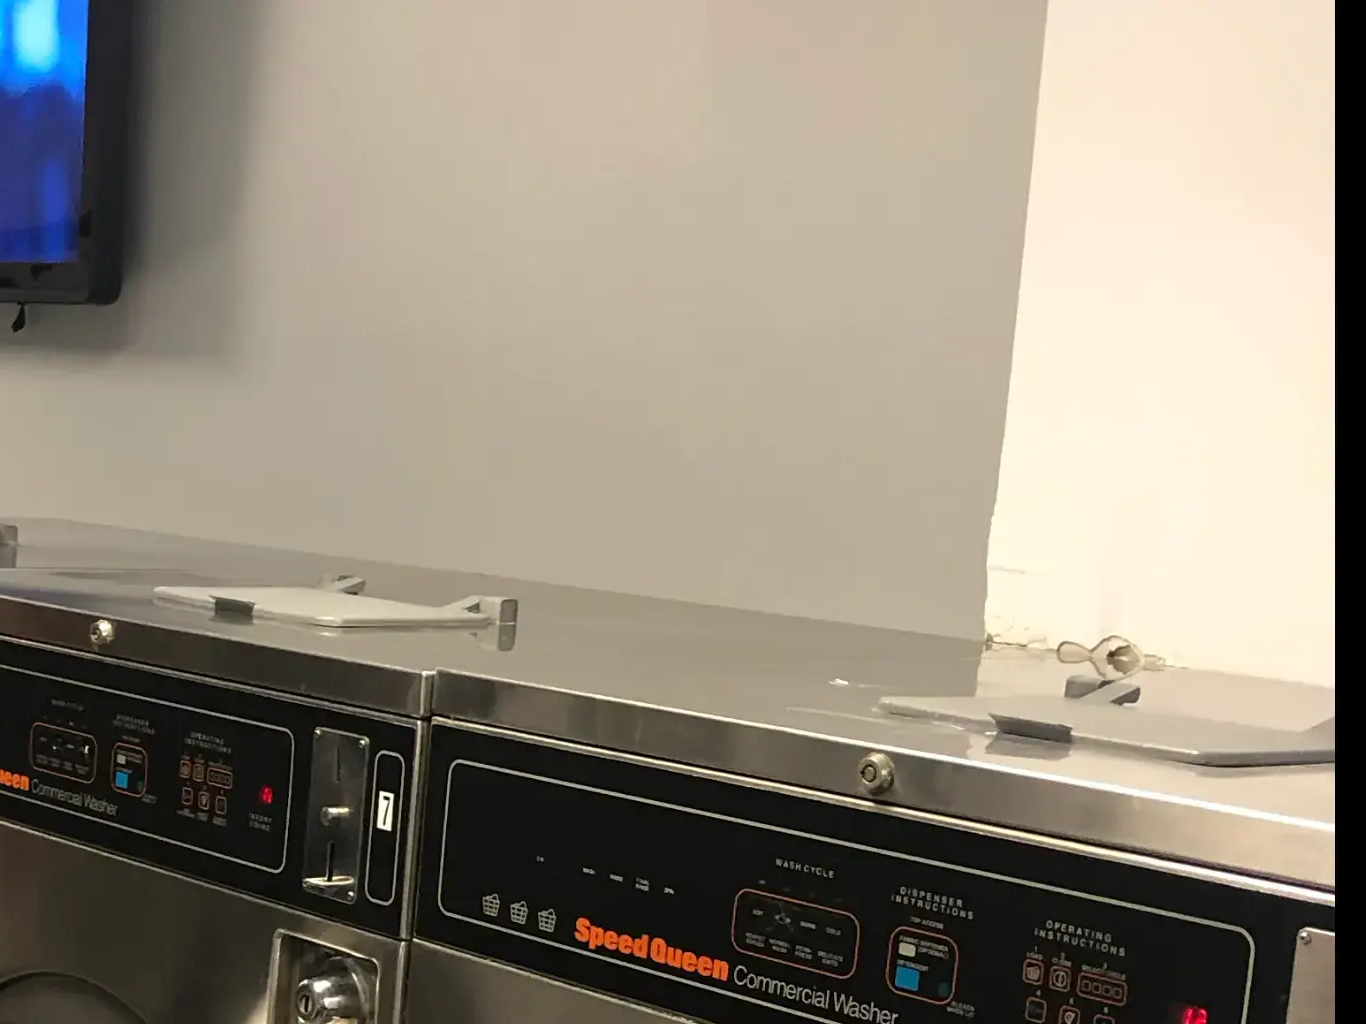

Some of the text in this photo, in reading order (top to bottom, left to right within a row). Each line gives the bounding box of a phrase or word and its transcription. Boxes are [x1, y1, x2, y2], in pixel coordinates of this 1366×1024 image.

[31, 778, 119, 816] Commercial Washer
[775, 858, 834, 879] WASH CYCLE
[891, 894, 974, 920] INSTRUCTIONS
[900, 886, 963, 908] DISPENSER
[1034, 927, 1126, 956] INSTRUCTIONS
[1045, 920, 1112, 943] OPERATING
[574, 917, 729, 982] Speed Queen
[734, 965, 829, 1010] Commercial
